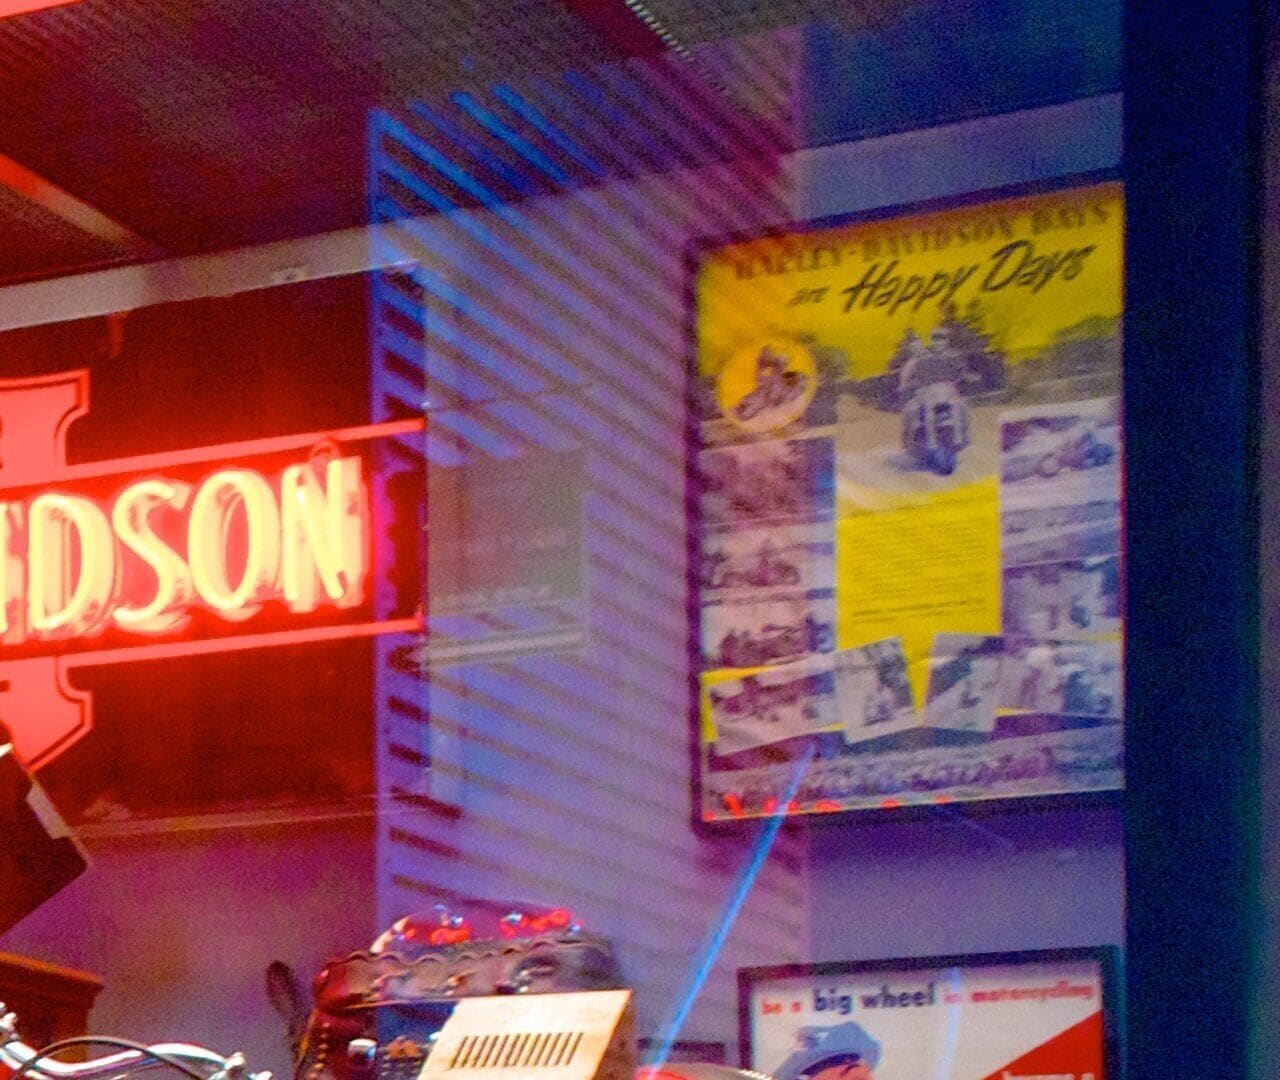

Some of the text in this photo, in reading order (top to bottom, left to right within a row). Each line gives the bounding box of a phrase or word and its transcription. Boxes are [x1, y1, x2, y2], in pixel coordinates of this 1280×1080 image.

[842, 258, 980, 318] Happy
[981, 239, 1100, 296] Days
[812, 986, 854, 1016] big
[860, 982, 937, 1010] wheel
